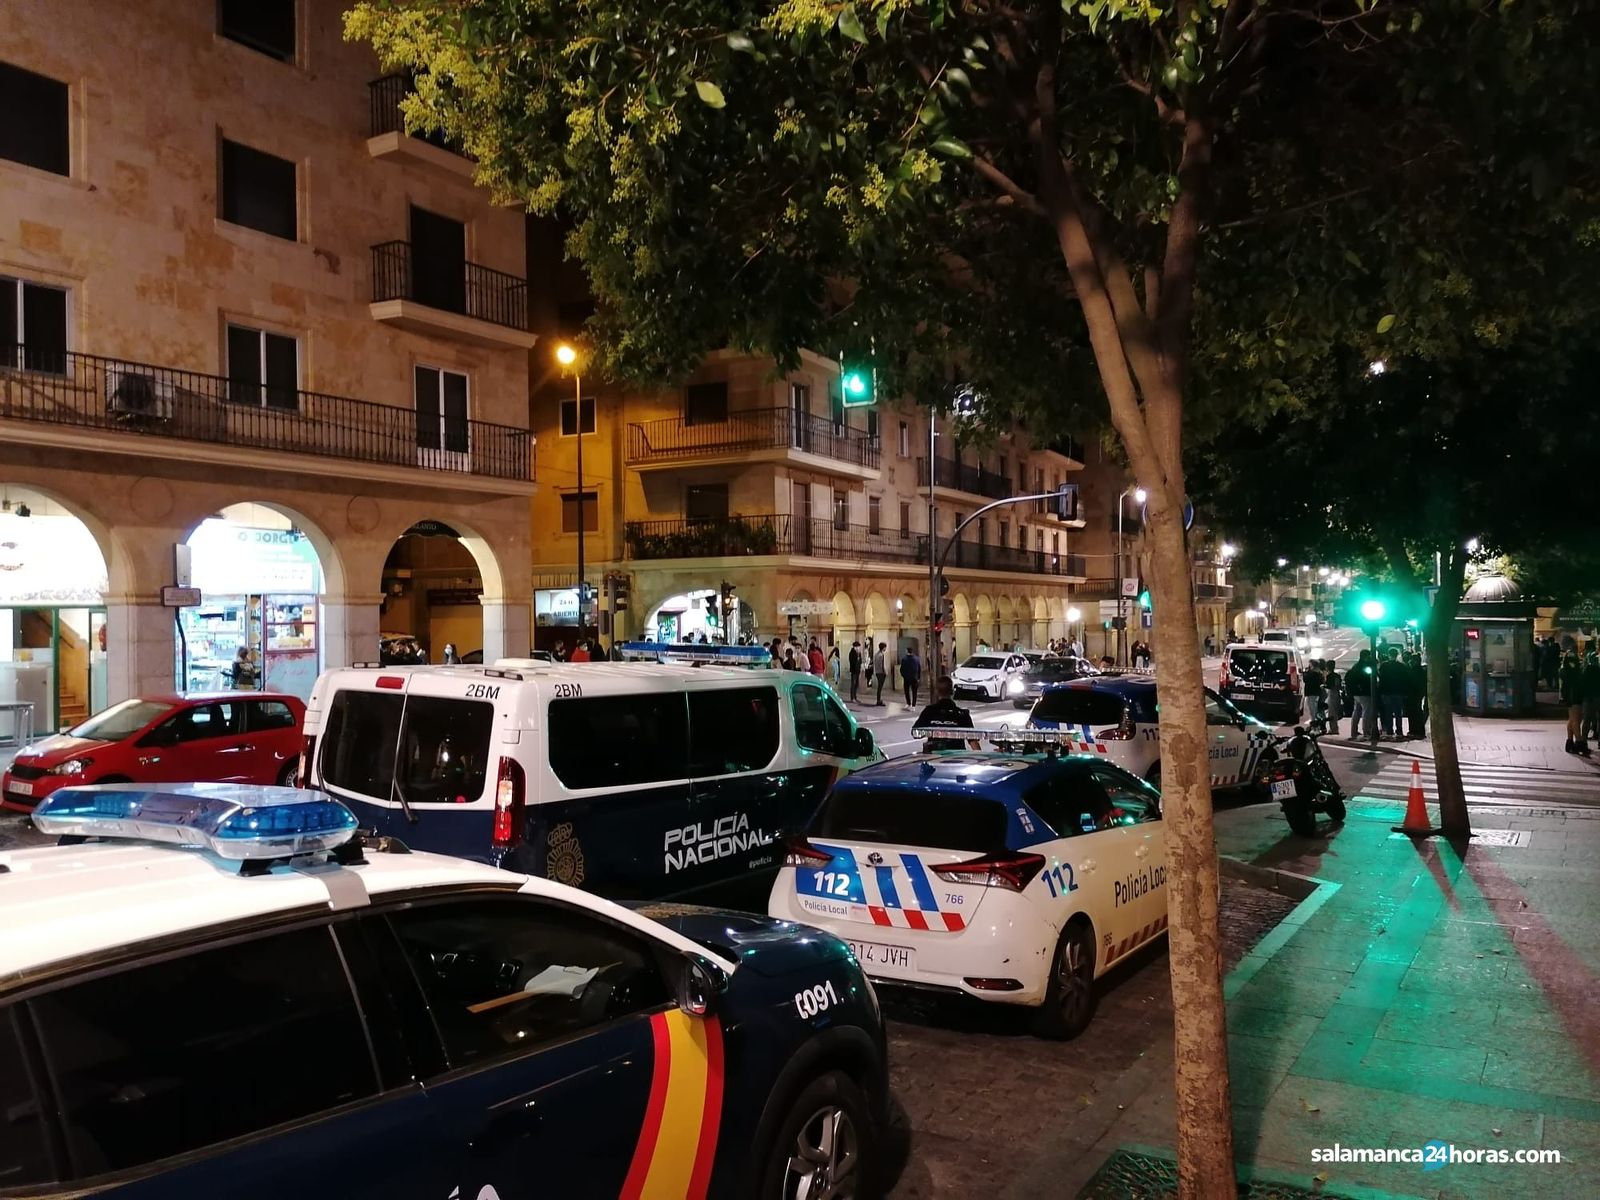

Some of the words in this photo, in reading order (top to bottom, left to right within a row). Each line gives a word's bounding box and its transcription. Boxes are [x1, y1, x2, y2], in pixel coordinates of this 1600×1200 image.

[465, 684, 501, 699] 2BM
[554, 683, 583, 698] 2BM
[1221, 745, 1239, 759] Local
[664, 811, 749, 851] POLICÍA
[664, 828, 774, 874] NACIONAL
[813, 871, 851, 896] 112
[1041, 862, 1078, 898] 112
[1114, 869, 1148, 908] Policía
[828, 904, 848, 915] Local
[945, 893, 964, 905] 766
[880, 947, 908, 967] JVH
[803, 979, 838, 1016] 091
